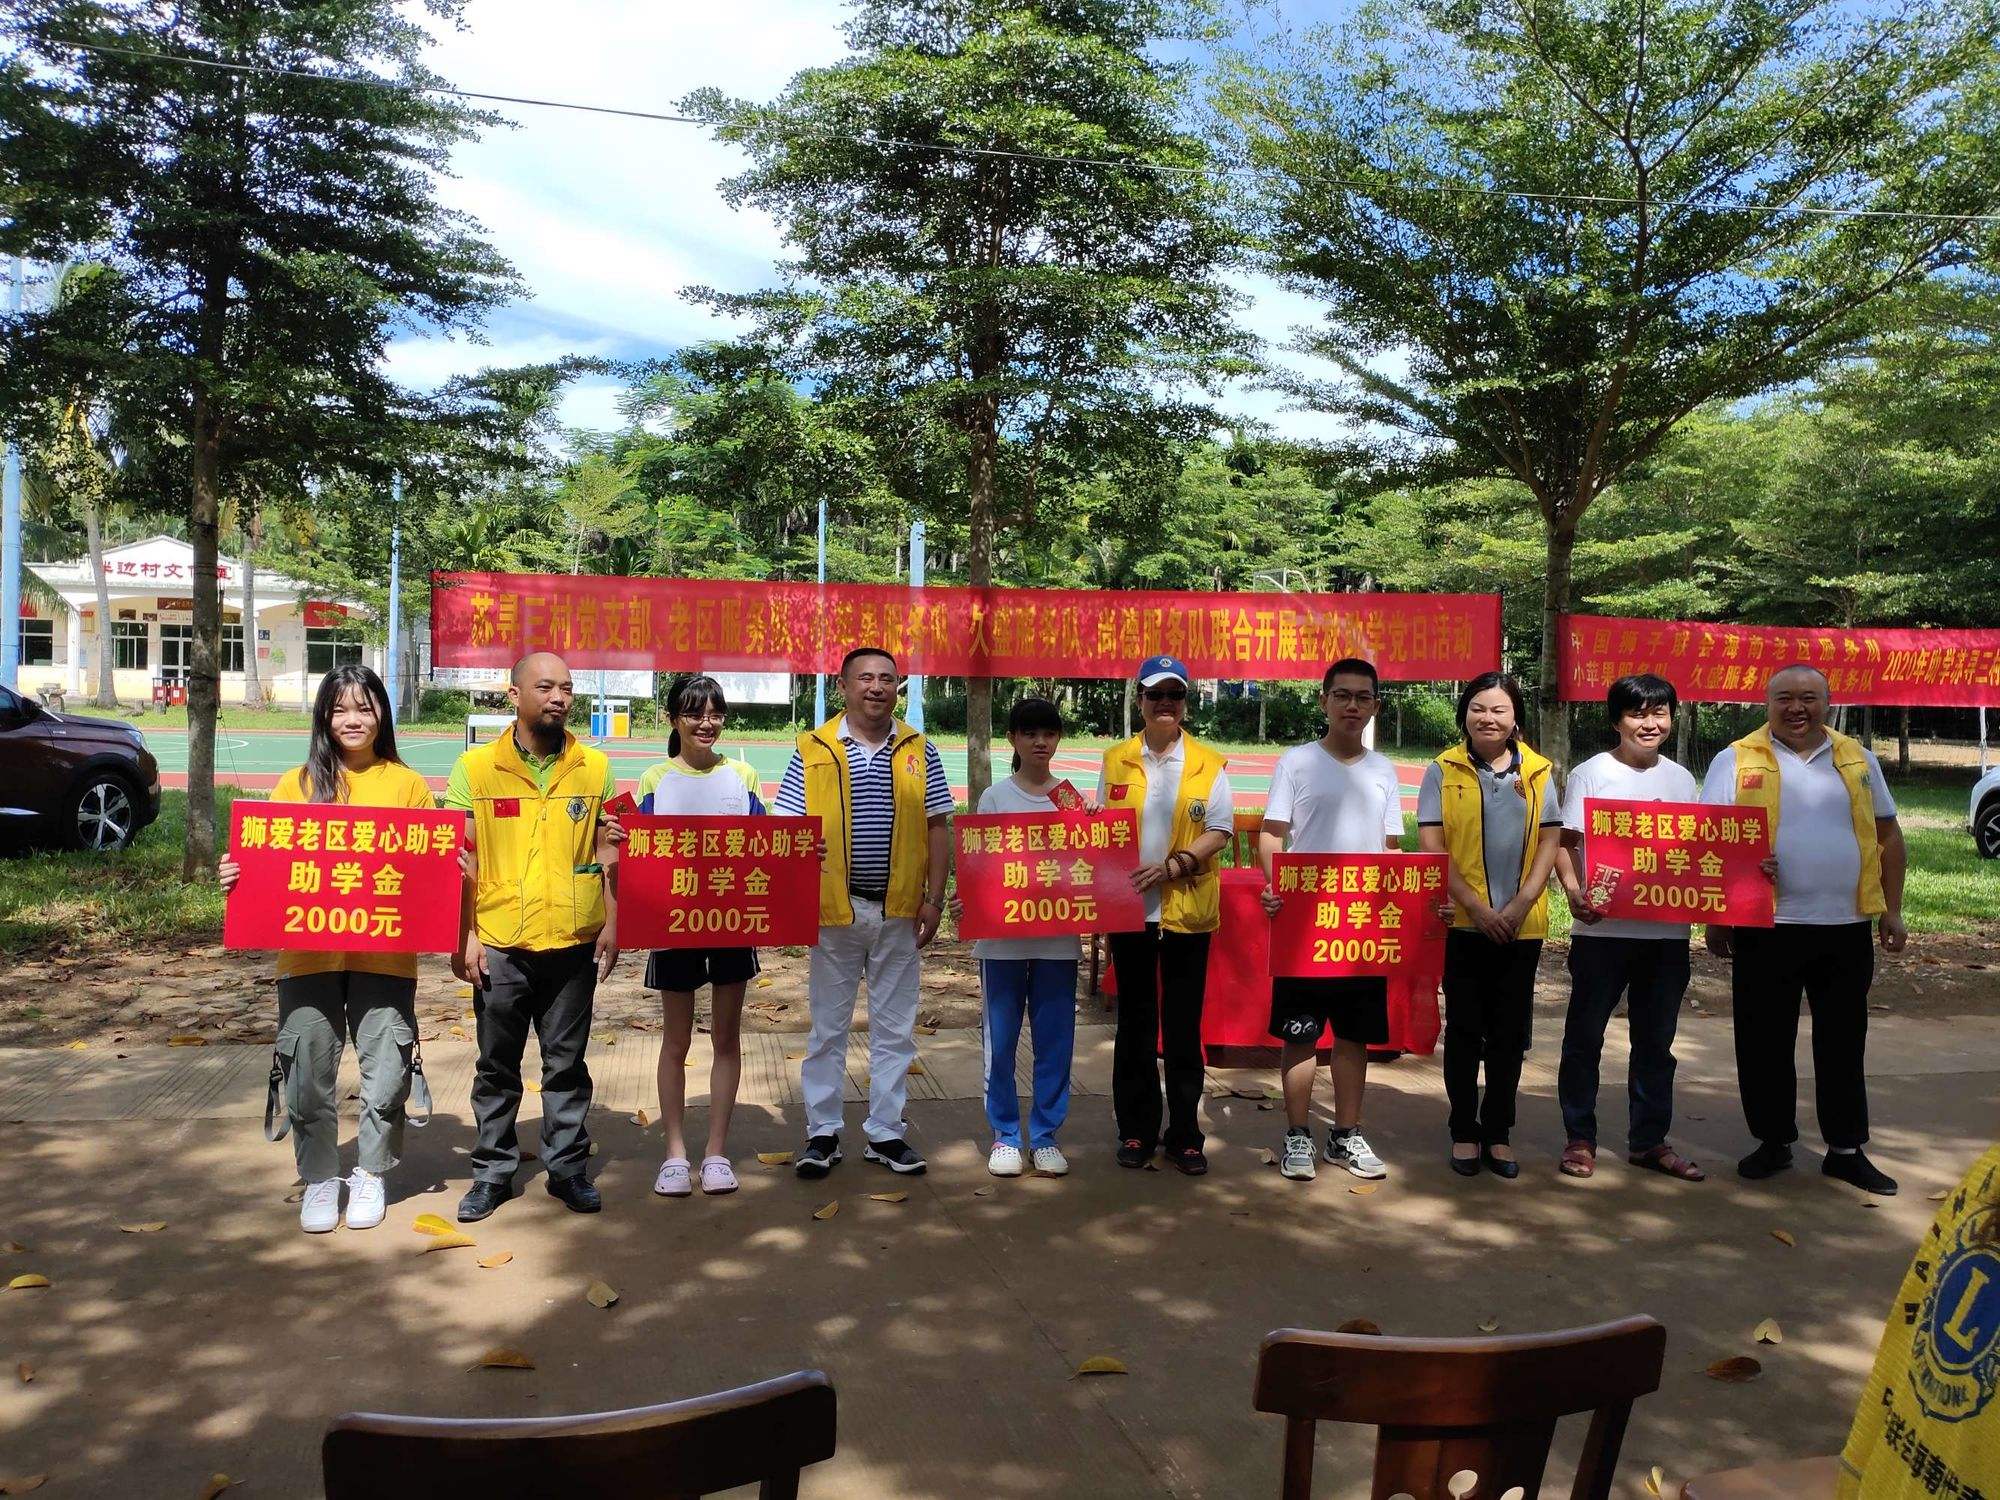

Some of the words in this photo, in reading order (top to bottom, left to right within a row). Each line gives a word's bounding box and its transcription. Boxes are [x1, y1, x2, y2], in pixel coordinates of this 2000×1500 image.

[241, 815, 456, 856] 狮爱老区爱心助学
[962, 820, 1131, 854] 狮爱老区爱心助学
[1592, 809, 1761, 845] 狮爱老区爱心助学
[628, 828, 814, 858] 狮爱老区爱心助学
[1003, 858, 1094, 888] 助学金
[1633, 847, 1723, 877] 助学金
[288, 861, 405, 895] 助学金
[671, 867, 771, 897] 助学金
[1279, 865, 1442, 893] 狮爱老区爱心助学
[1004, 895, 1097, 923] 2000元
[1633, 883, 1727, 912] 2000元
[284, 906, 402, 938] 2000元
[669, 907, 770, 934] 2000元
[1315, 902, 1403, 929] 助学金
[1313, 938, 1401, 964] 2000元
